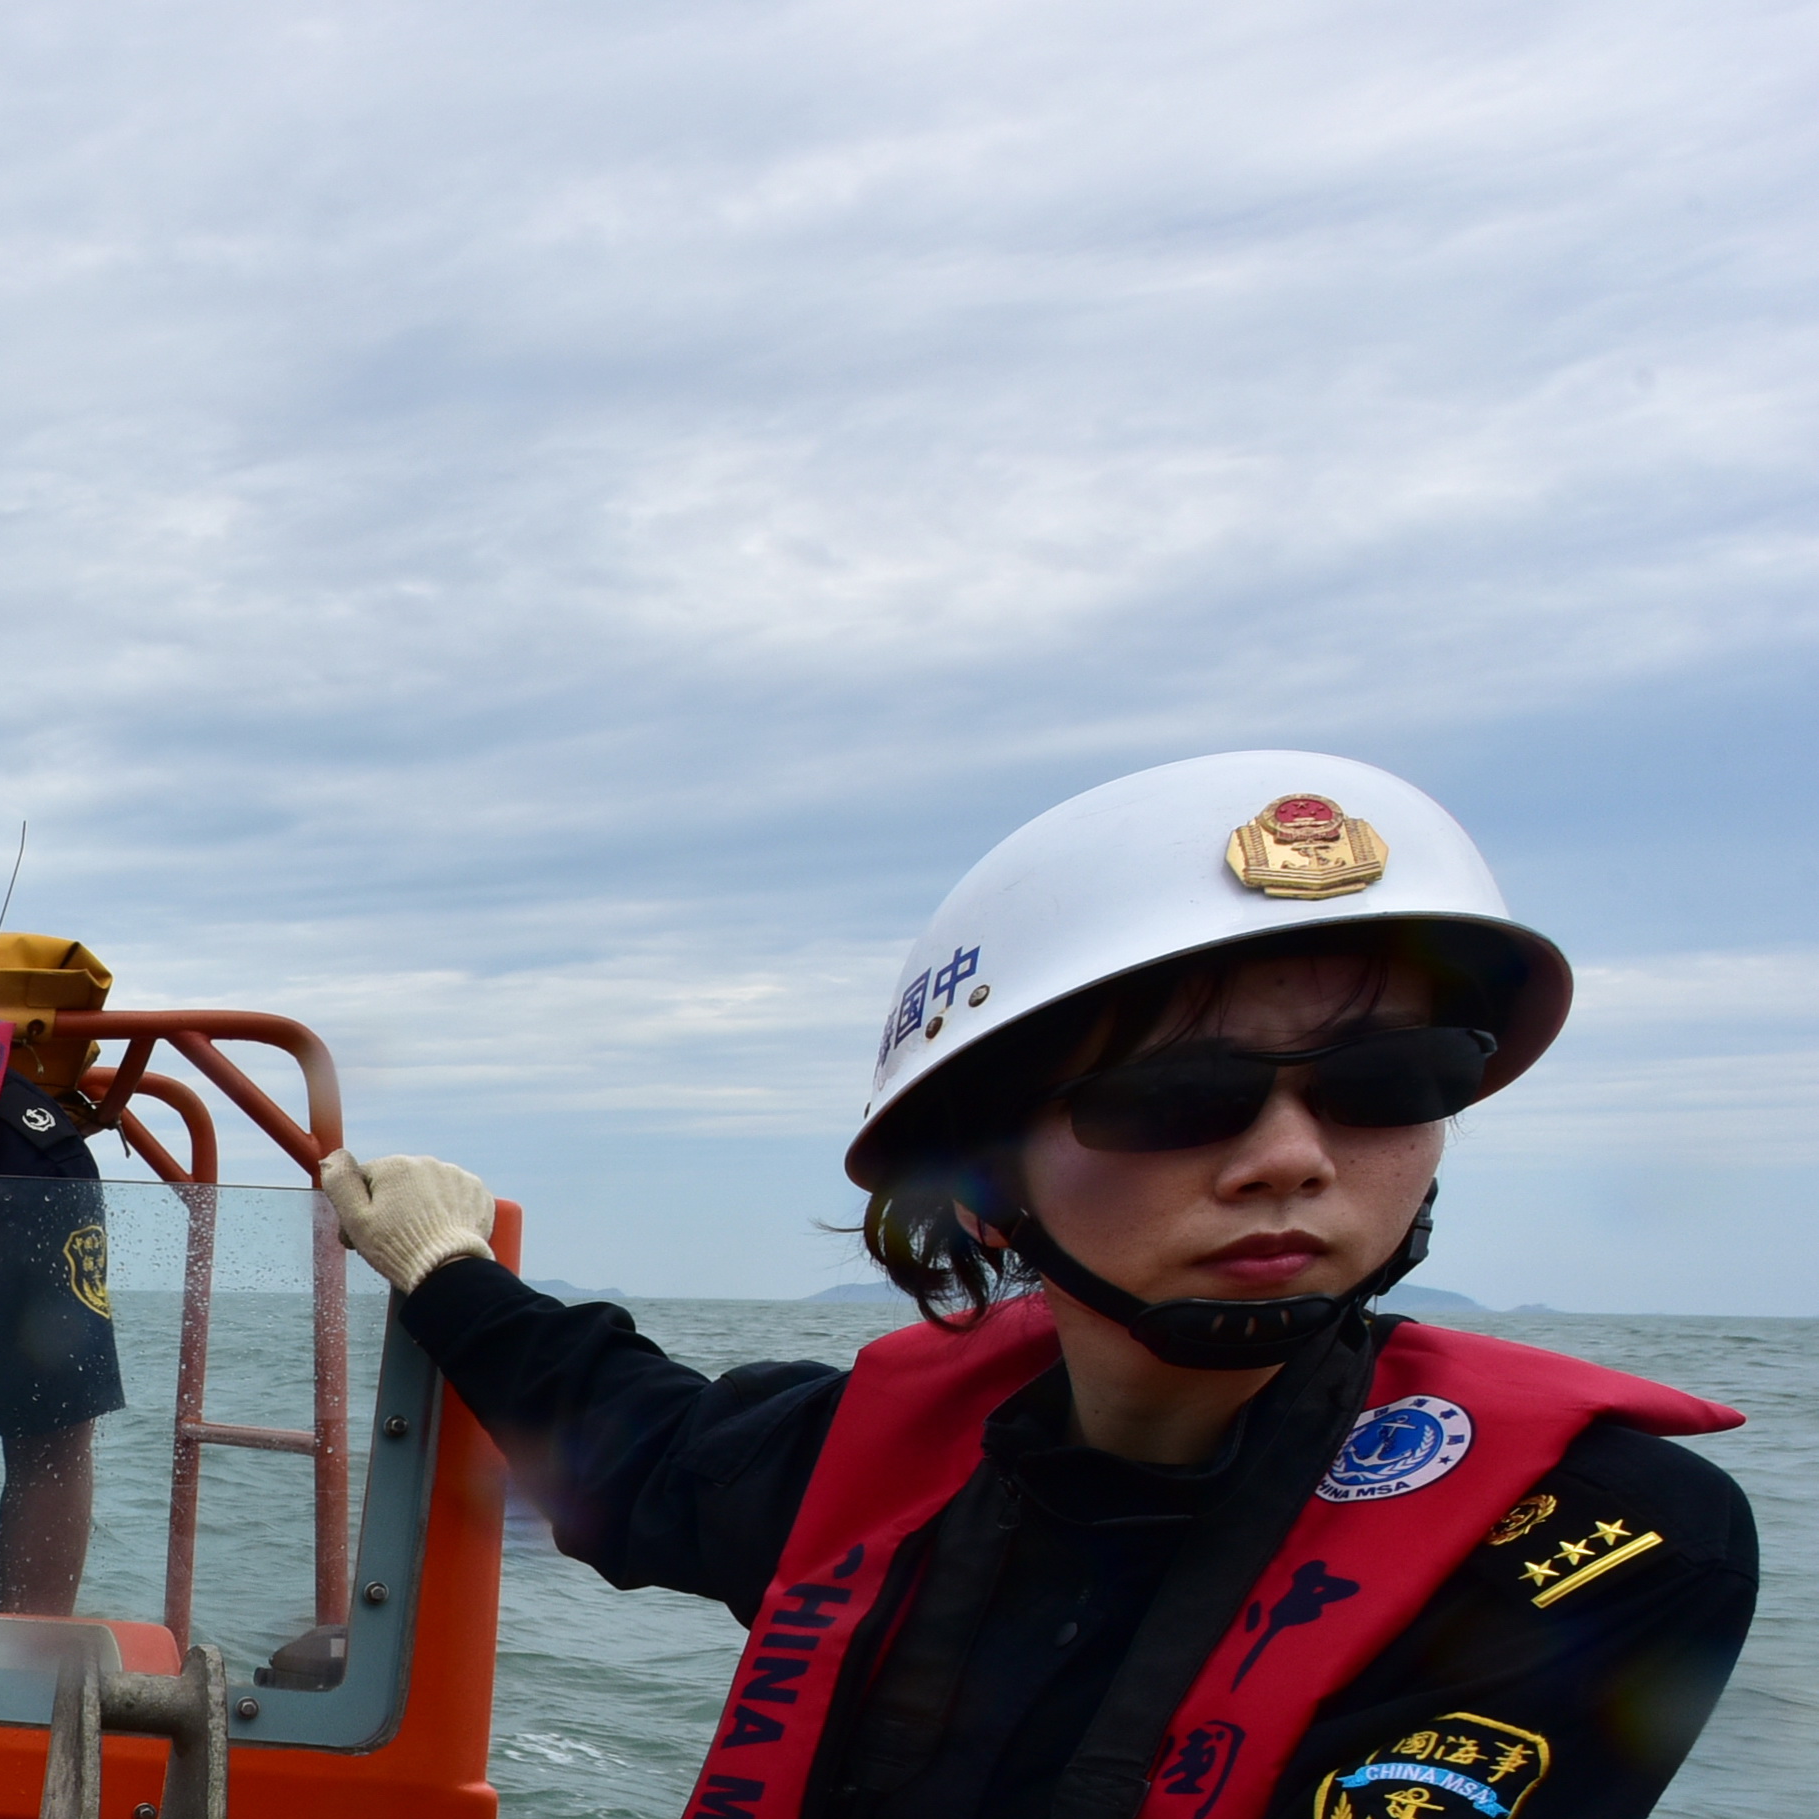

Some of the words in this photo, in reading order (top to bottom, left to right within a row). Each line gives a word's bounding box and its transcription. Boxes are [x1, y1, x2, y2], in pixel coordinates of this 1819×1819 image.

[1355, 1481, 1411, 1497] MSA
[1366, 1765, 1435, 1784] CHINA
[1441, 1775, 1492, 1805] MSA
